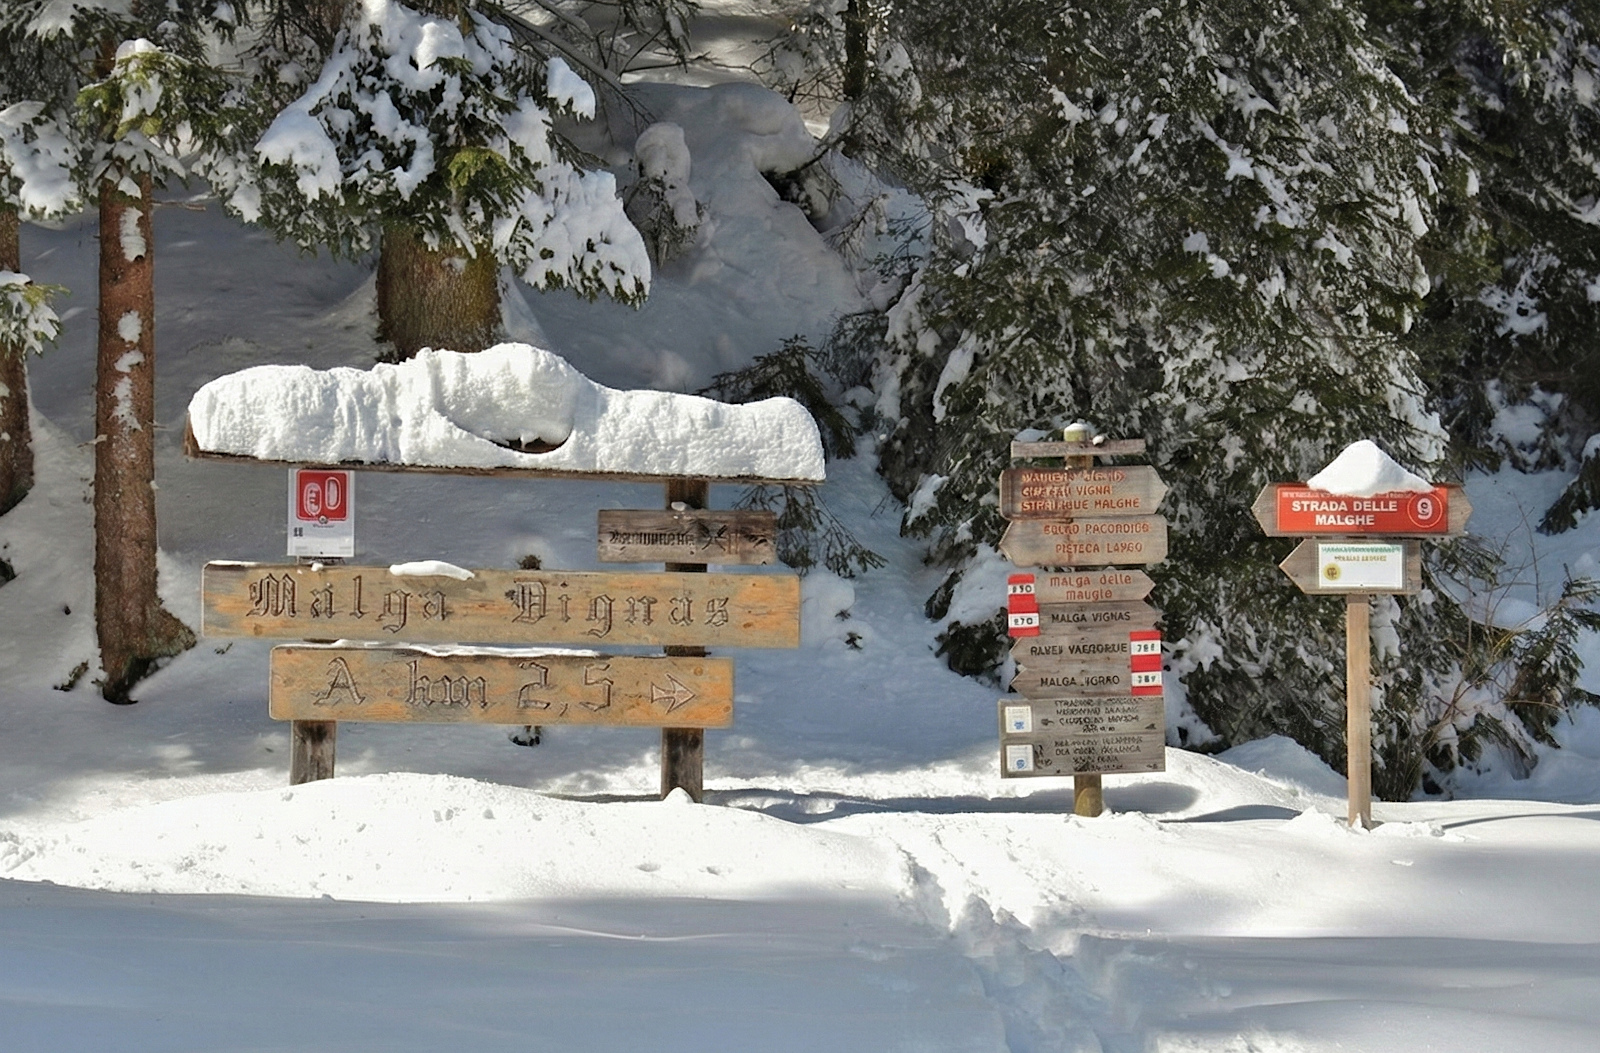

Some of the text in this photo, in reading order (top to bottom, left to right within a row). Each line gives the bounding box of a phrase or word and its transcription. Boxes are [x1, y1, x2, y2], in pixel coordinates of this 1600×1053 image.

[1291, 500, 1398, 512] STRADA DELLE
[1315, 514, 1375, 526] MALGHE
[1100, 573, 1132, 585] delle
[246, 572, 453, 634] Malga
[1051, 611, 1131, 623] MALGA VIGNAS
[311, 655, 366, 706] A
[516, 661, 614, 717] 2,5
[1040, 676, 1077, 687] MALGA
